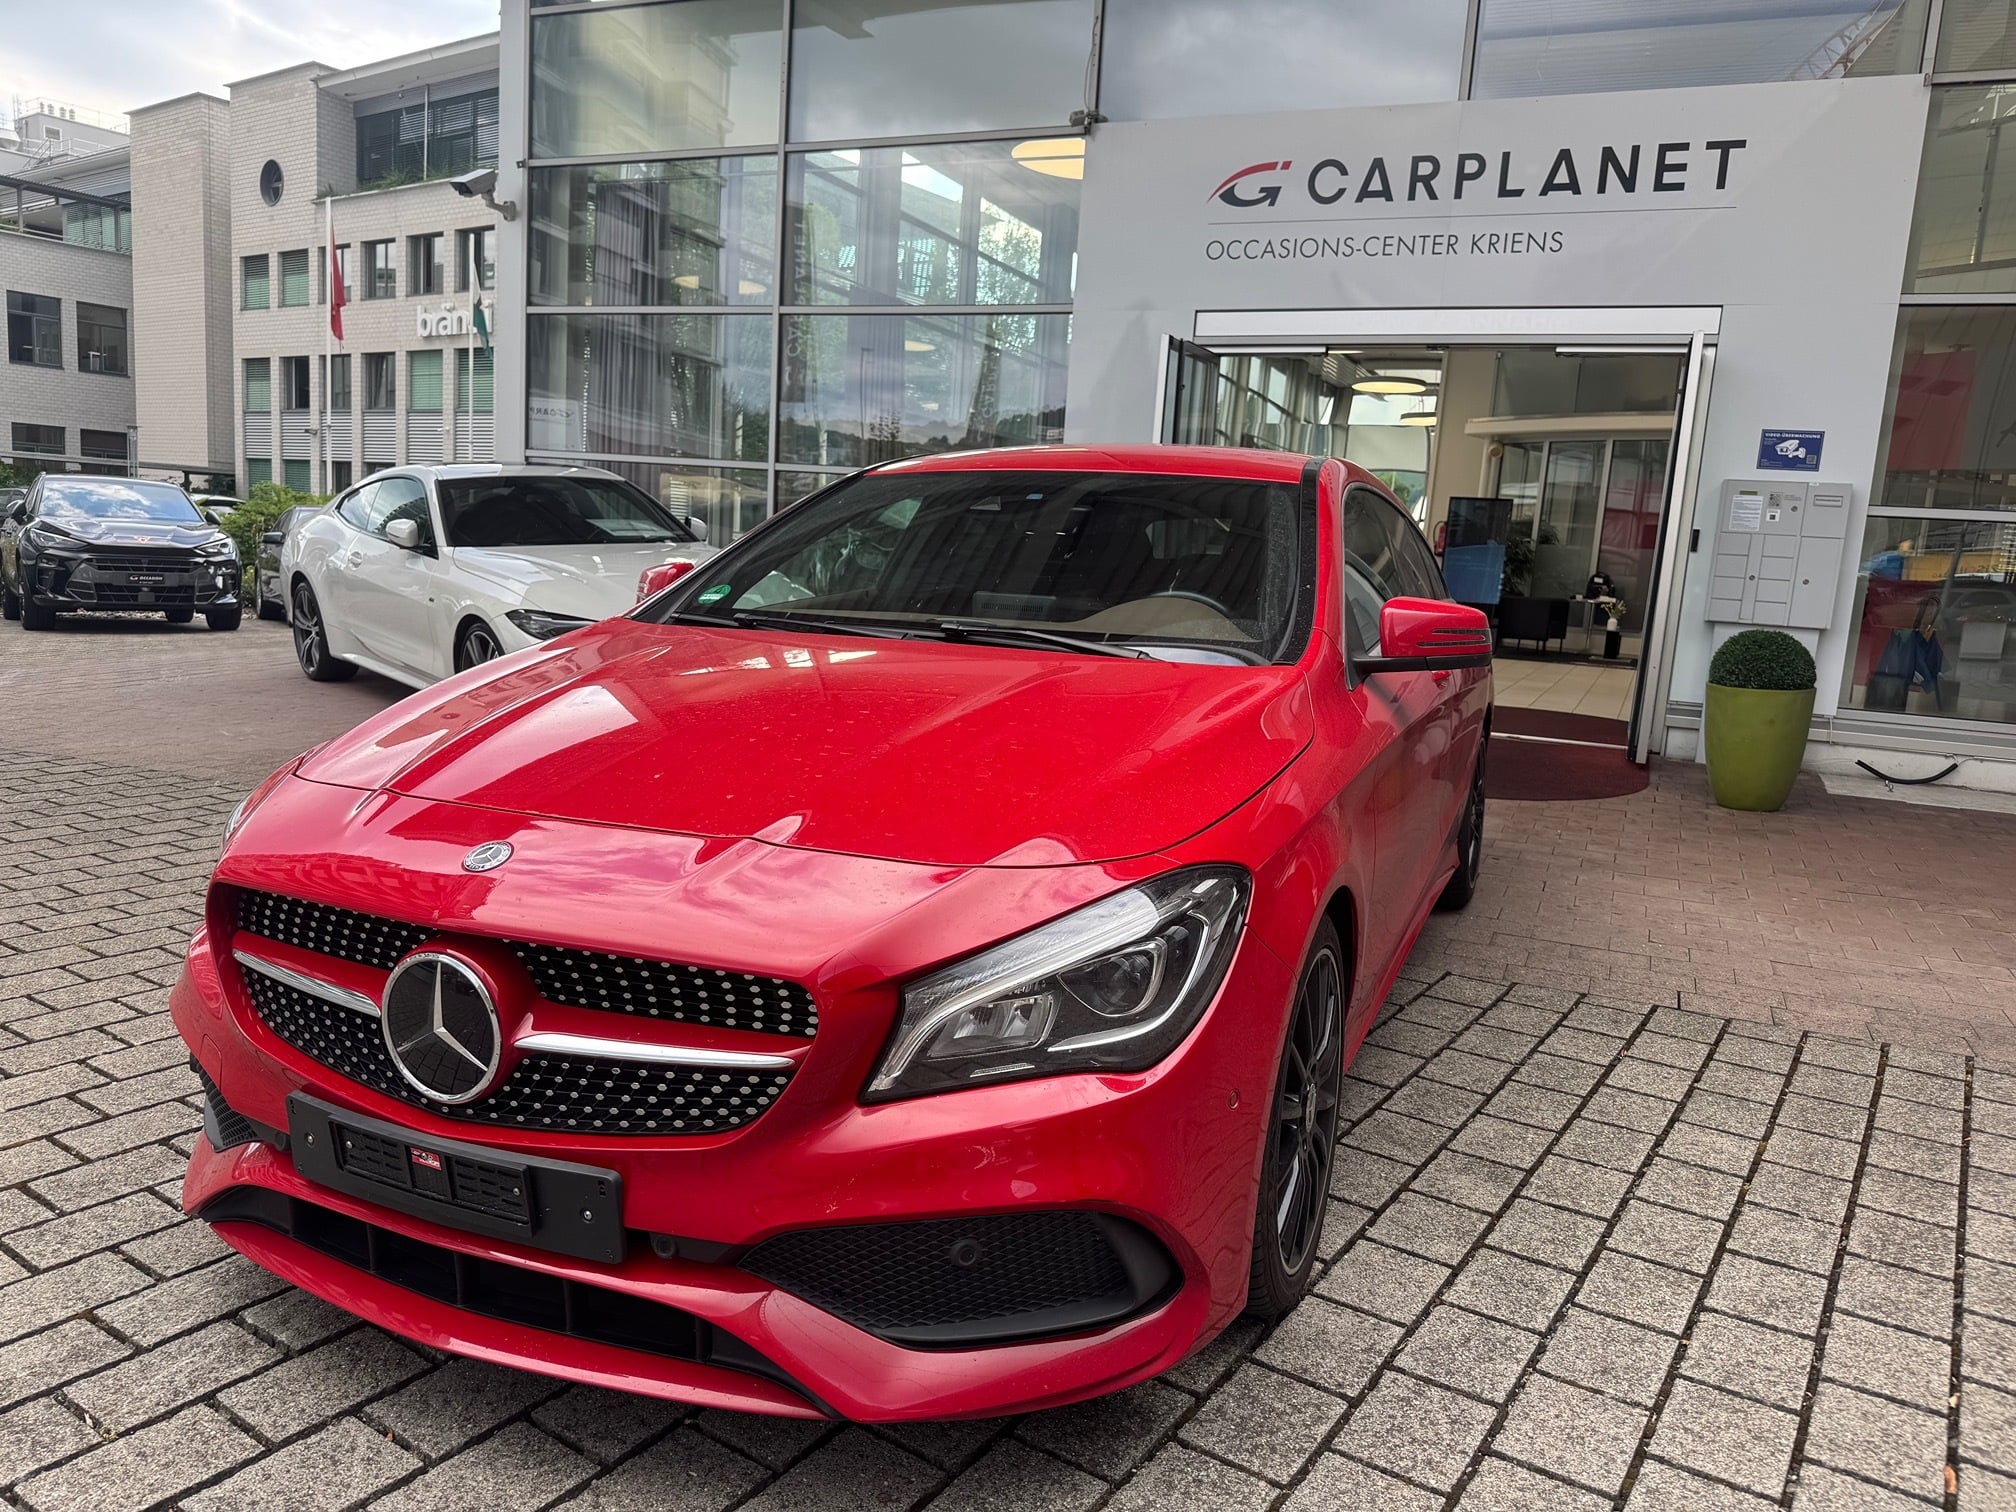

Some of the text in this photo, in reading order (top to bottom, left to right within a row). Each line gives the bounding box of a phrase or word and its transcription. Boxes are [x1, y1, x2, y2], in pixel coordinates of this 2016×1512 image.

[1307, 139, 1748, 205] CARPLANET
[1205, 231, 1564, 261] OCCASIONS-CENTER KRIENS
